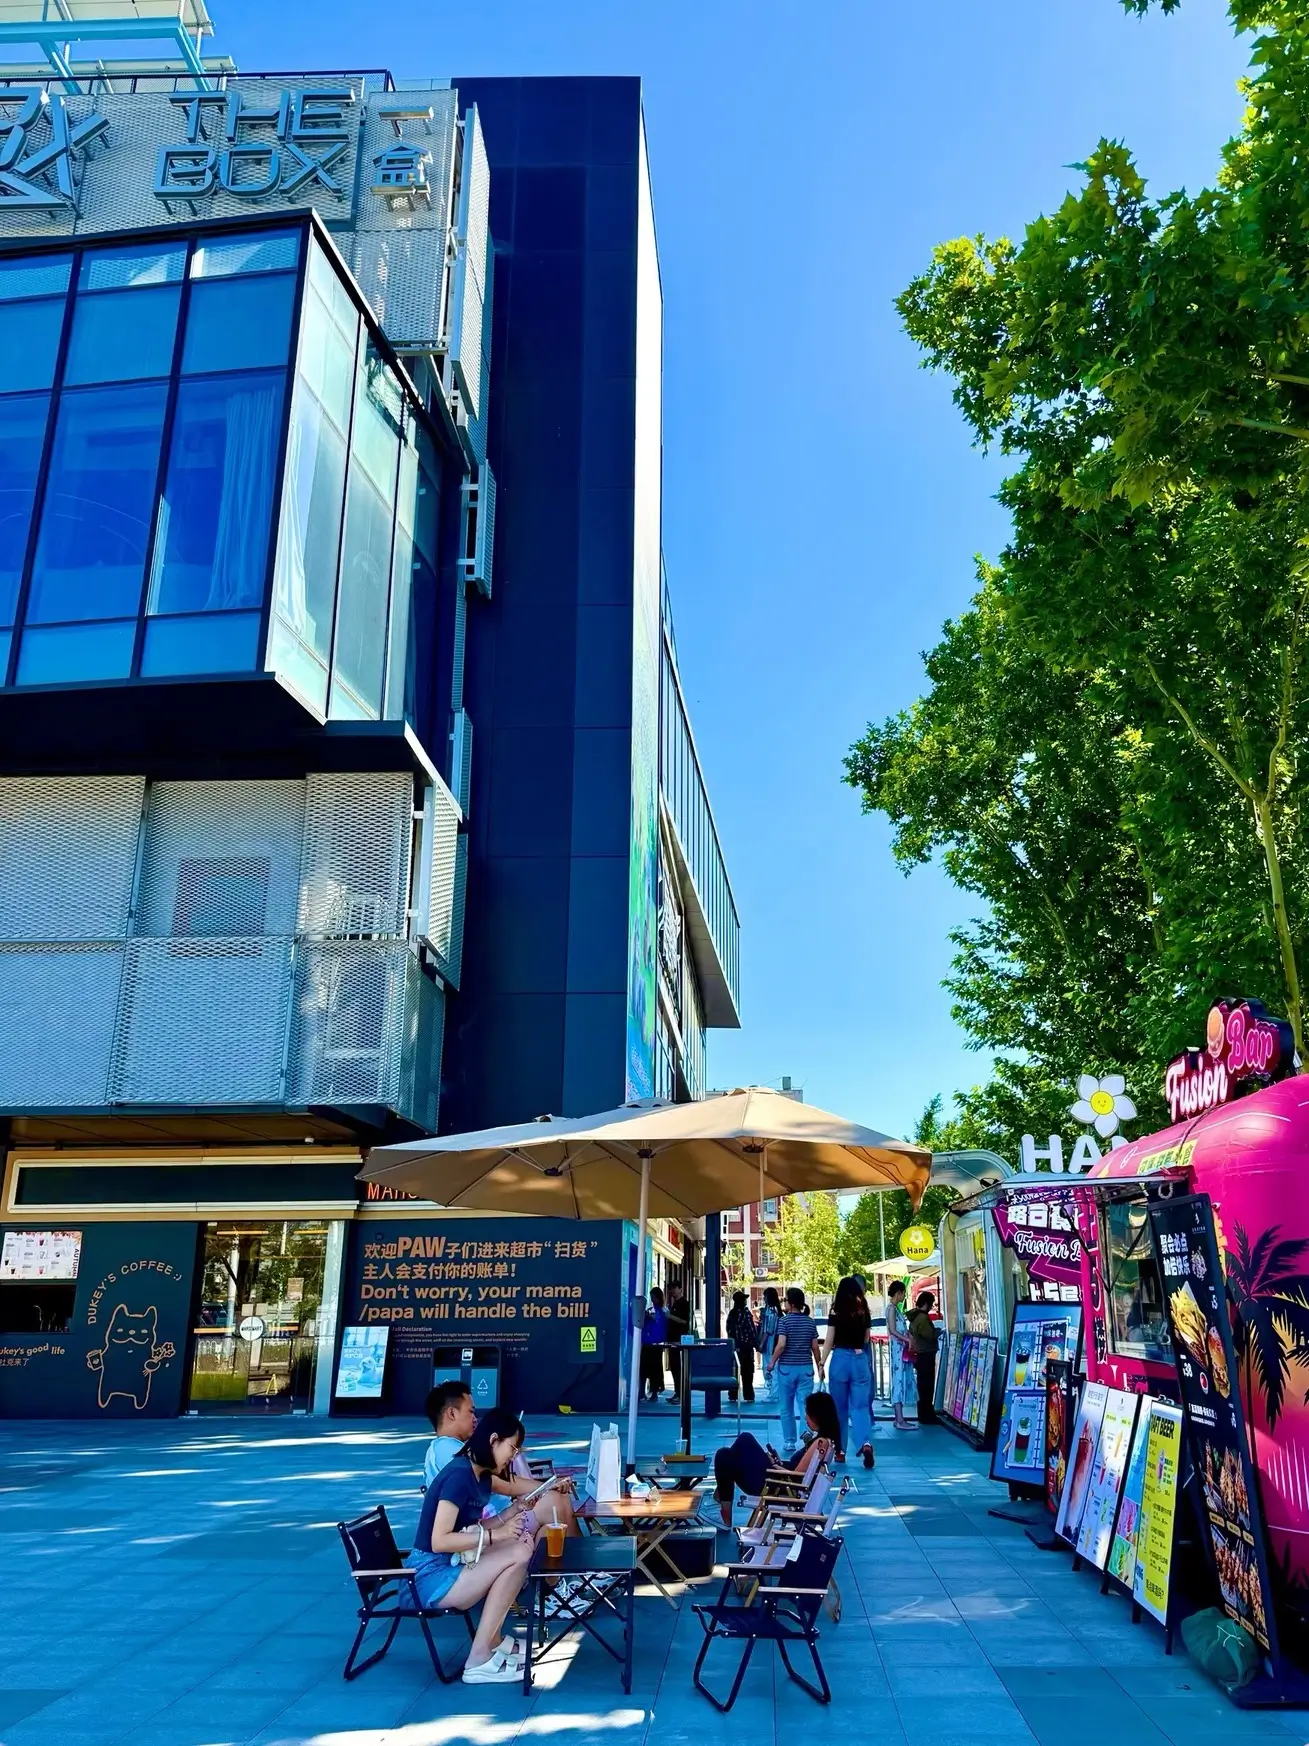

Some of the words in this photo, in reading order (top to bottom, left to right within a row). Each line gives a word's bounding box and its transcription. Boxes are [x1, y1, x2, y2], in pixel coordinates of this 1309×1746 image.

[169, 89, 355, 143] THE
[154, 143, 349, 201] BOX
[1166, 1053, 1228, 1122] Fusion
[1226, 1009, 1273, 1074] Bar
[1021, 1134, 1131, 1174] HA
[907, 1246, 929, 1254] Hana
[1014, 1230, 1069, 1259] Fusion
[1160, 1232, 1188, 1254] 聚会必点
[121, 1260, 173, 1275] COFFEE
[1163, 1255, 1191, 1276] 加倍快乐
[414, 1286, 472, 1301] worry,
[478, 1286, 521, 1301] your
[525, 1286, 582, 1298] mama
[359, 1304, 414, 1321] /papa
[420, 1303, 449, 1319] will
[454, 1303, 516, 1318] handle
[522, 1303, 552, 1318] the
[557, 1302, 590, 1318] bill!
[0, 1347, 25, 1357] ukey's
[26, 1343, 49, 1357] good
[51, 1346, 66, 1355] life
[1159, 1417, 1175, 1440] BEER
